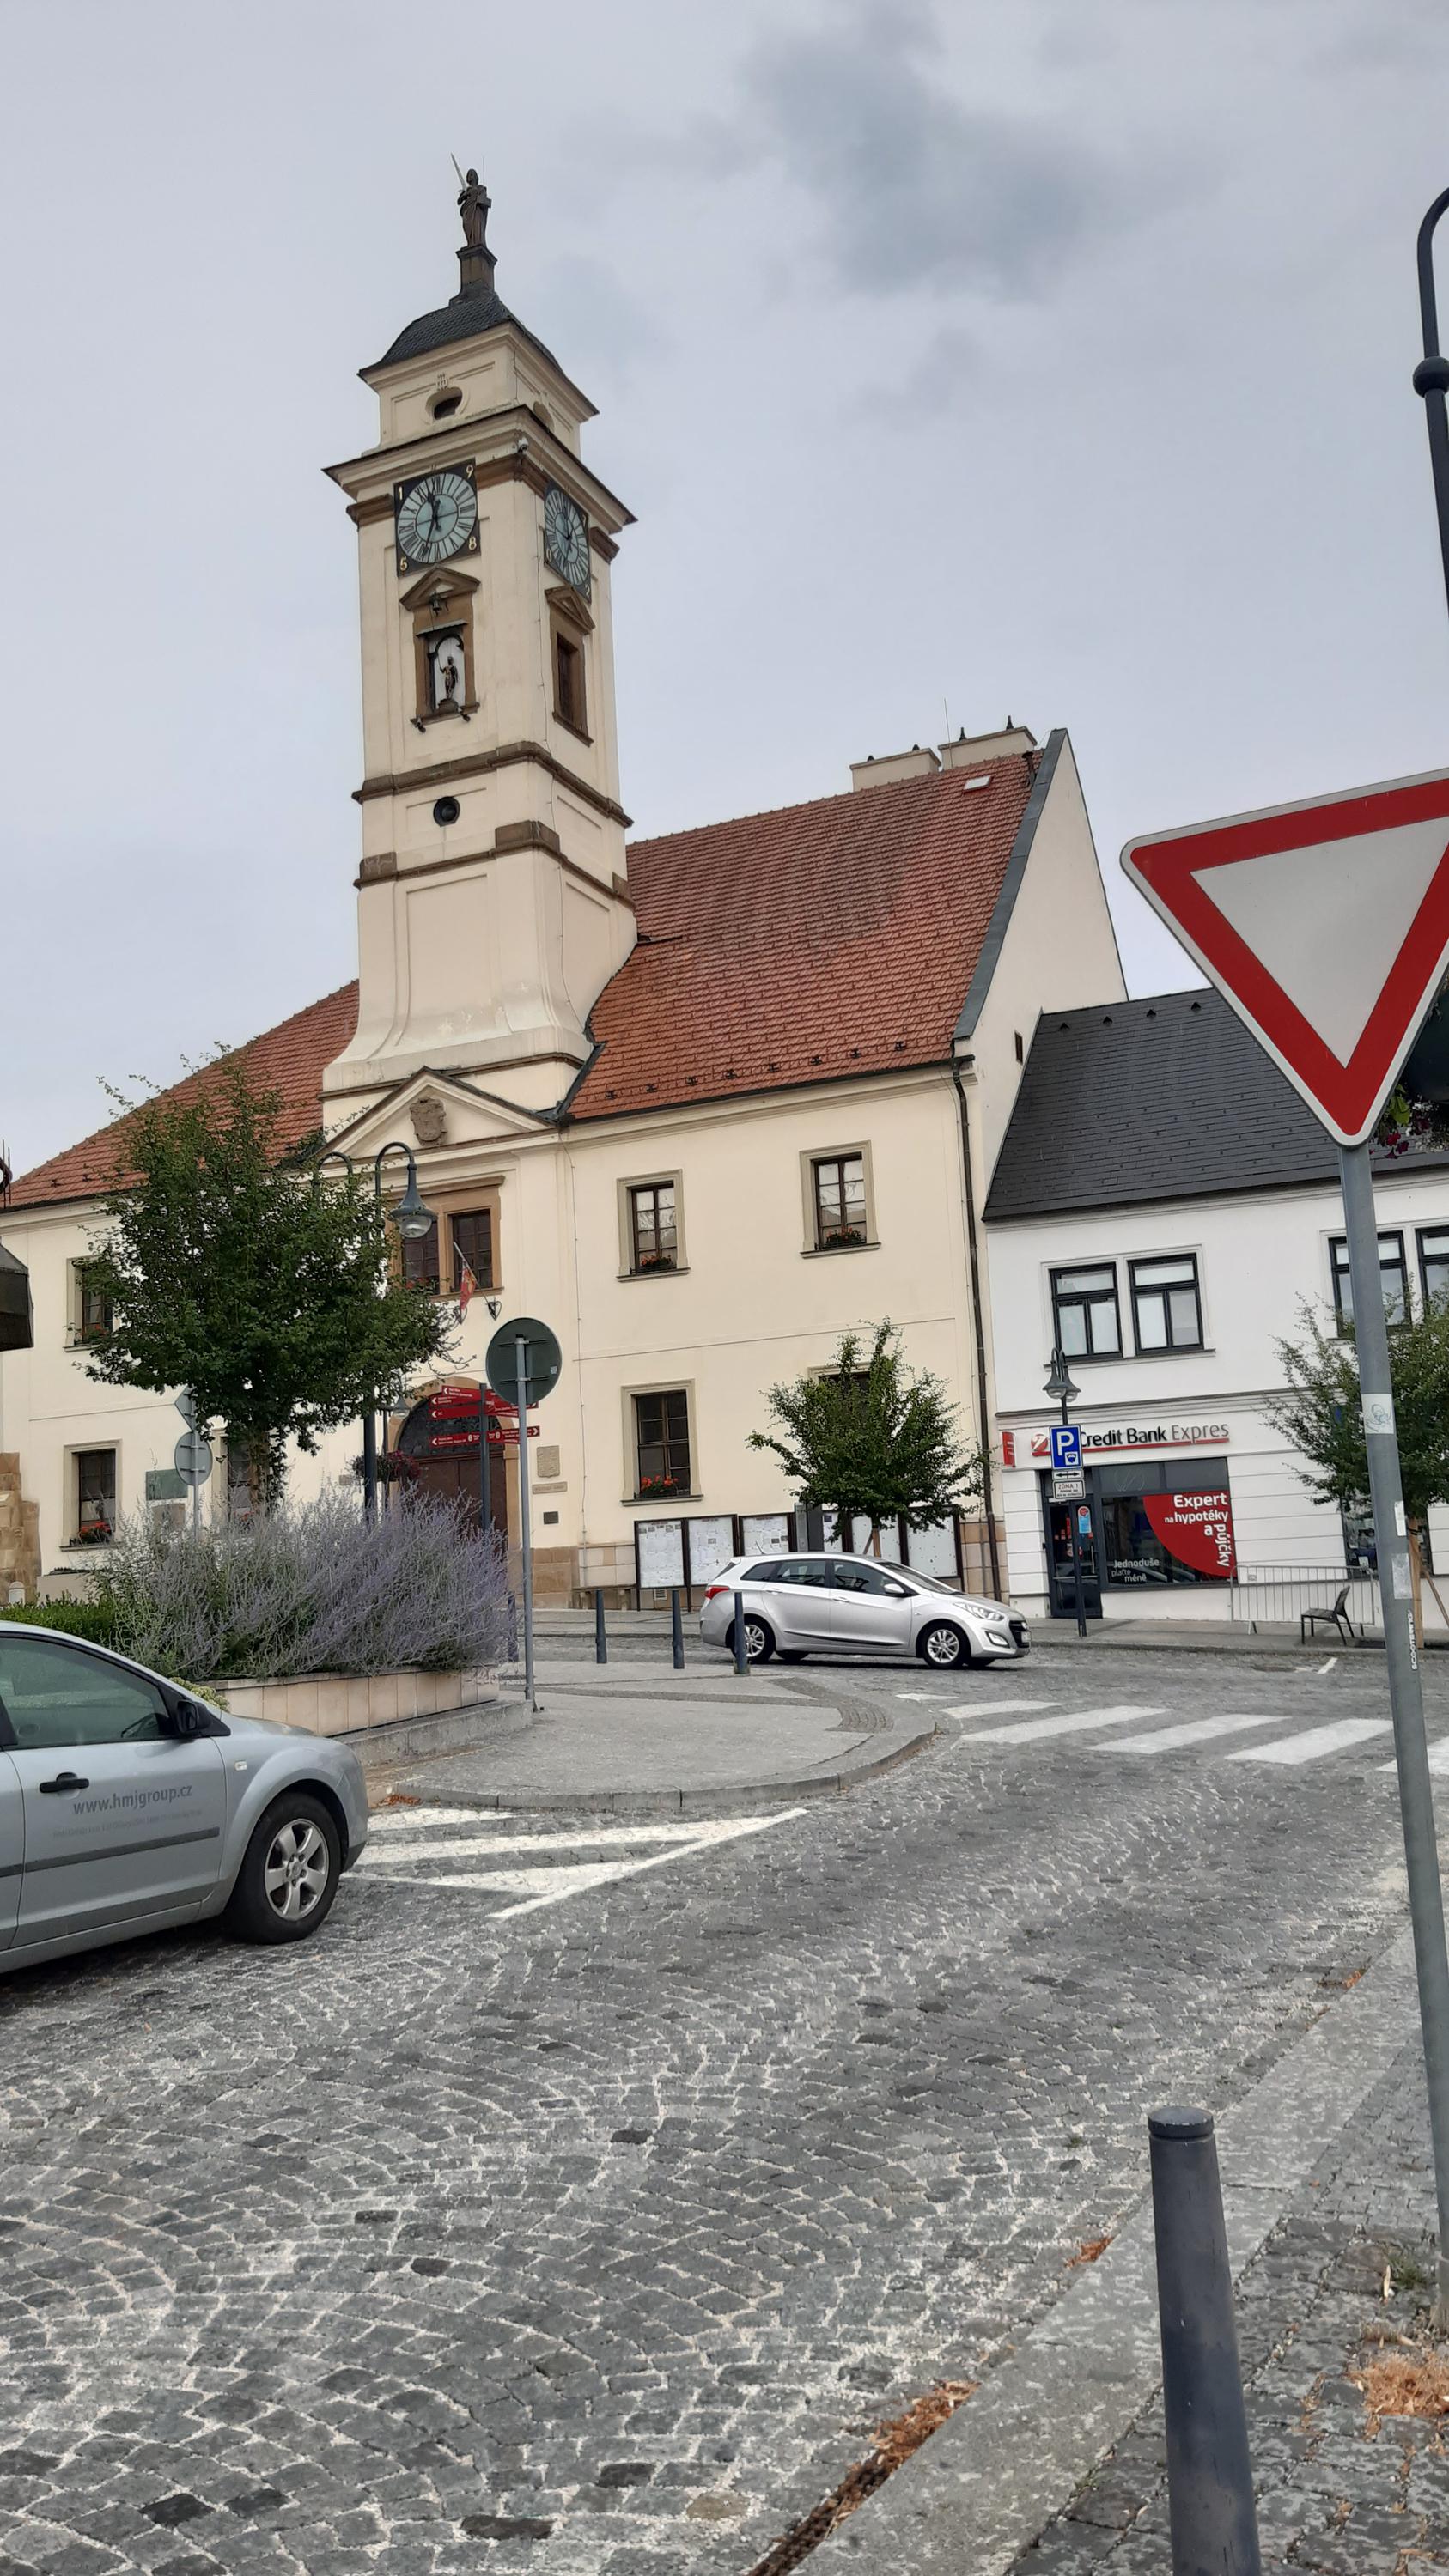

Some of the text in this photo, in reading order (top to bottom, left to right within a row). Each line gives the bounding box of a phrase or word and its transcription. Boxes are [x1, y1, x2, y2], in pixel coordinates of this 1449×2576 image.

[466, 465, 474, 478] 9
[469, 536, 477, 550] 8
[399, 556, 408, 570] 5
[1127, 1425, 1167, 1444] Bank
[1172, 1424, 1229, 1444] Expres
[1056, 1431, 1074, 1456] P
[1173, 1492, 1228, 1510] Expert
[1174, 1510, 1228, 1524] hypotéky
[1204, 1524, 1213, 1536] a
[1213, 1523, 1233, 1567] půjčky
[1113, 1558, 1160, 1568] Jednoduše
[1124, 1573, 1147, 1583] méně
[74, 1784, 193, 1814] www.hmjgroup.cz
